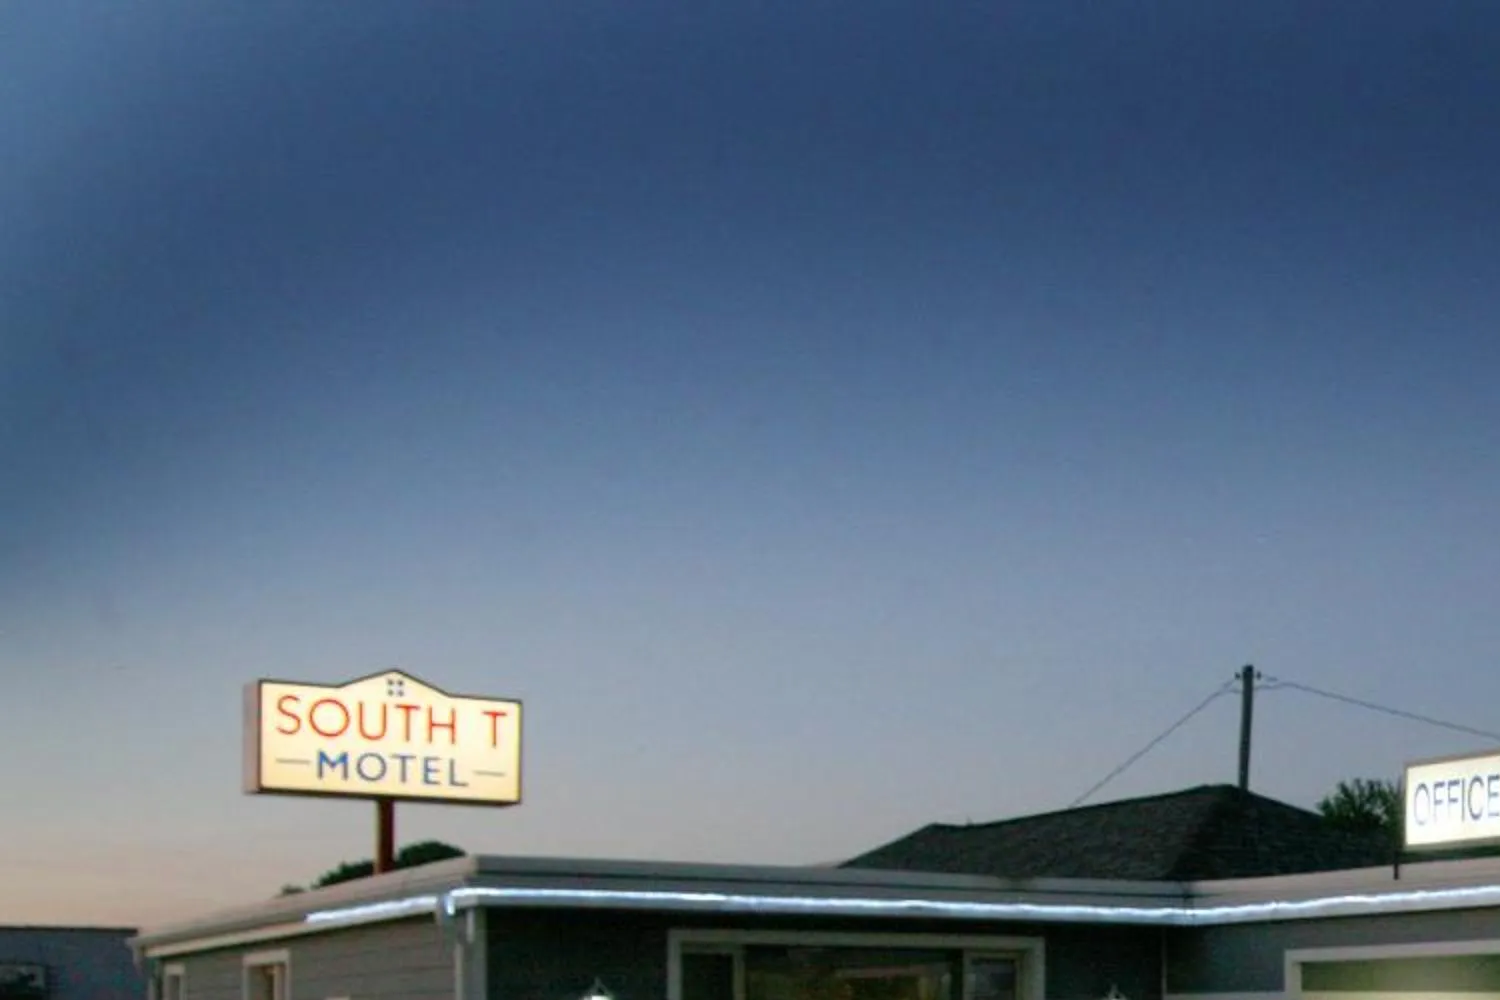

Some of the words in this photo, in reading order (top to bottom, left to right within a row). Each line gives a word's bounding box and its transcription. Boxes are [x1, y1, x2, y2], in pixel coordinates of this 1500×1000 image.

[275, 695, 457, 745] SOUTH
[483, 711, 507, 748] T
[316, 749, 469, 787] MOTEL
[1414, 774, 1500, 826] OFFICE
